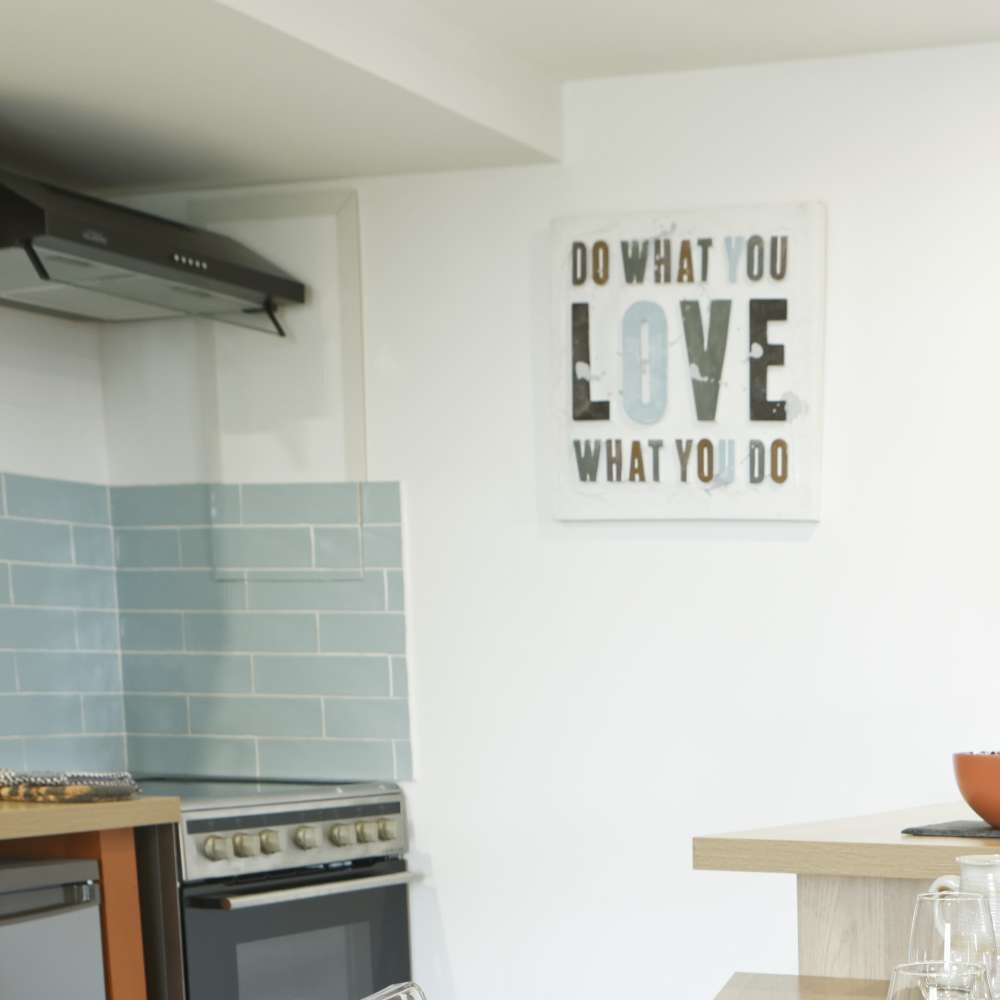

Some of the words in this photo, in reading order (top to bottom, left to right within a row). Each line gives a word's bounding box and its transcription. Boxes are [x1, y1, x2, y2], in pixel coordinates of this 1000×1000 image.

[572, 240, 609, 286] DO
[621, 238, 713, 284] WHAT
[724, 235, 788, 284] YOU
[571, 298, 788, 425] LOVE
[573, 439, 663, 482] WHAT
[676, 438, 736, 484] YOU
[749, 438, 788, 484] DO
